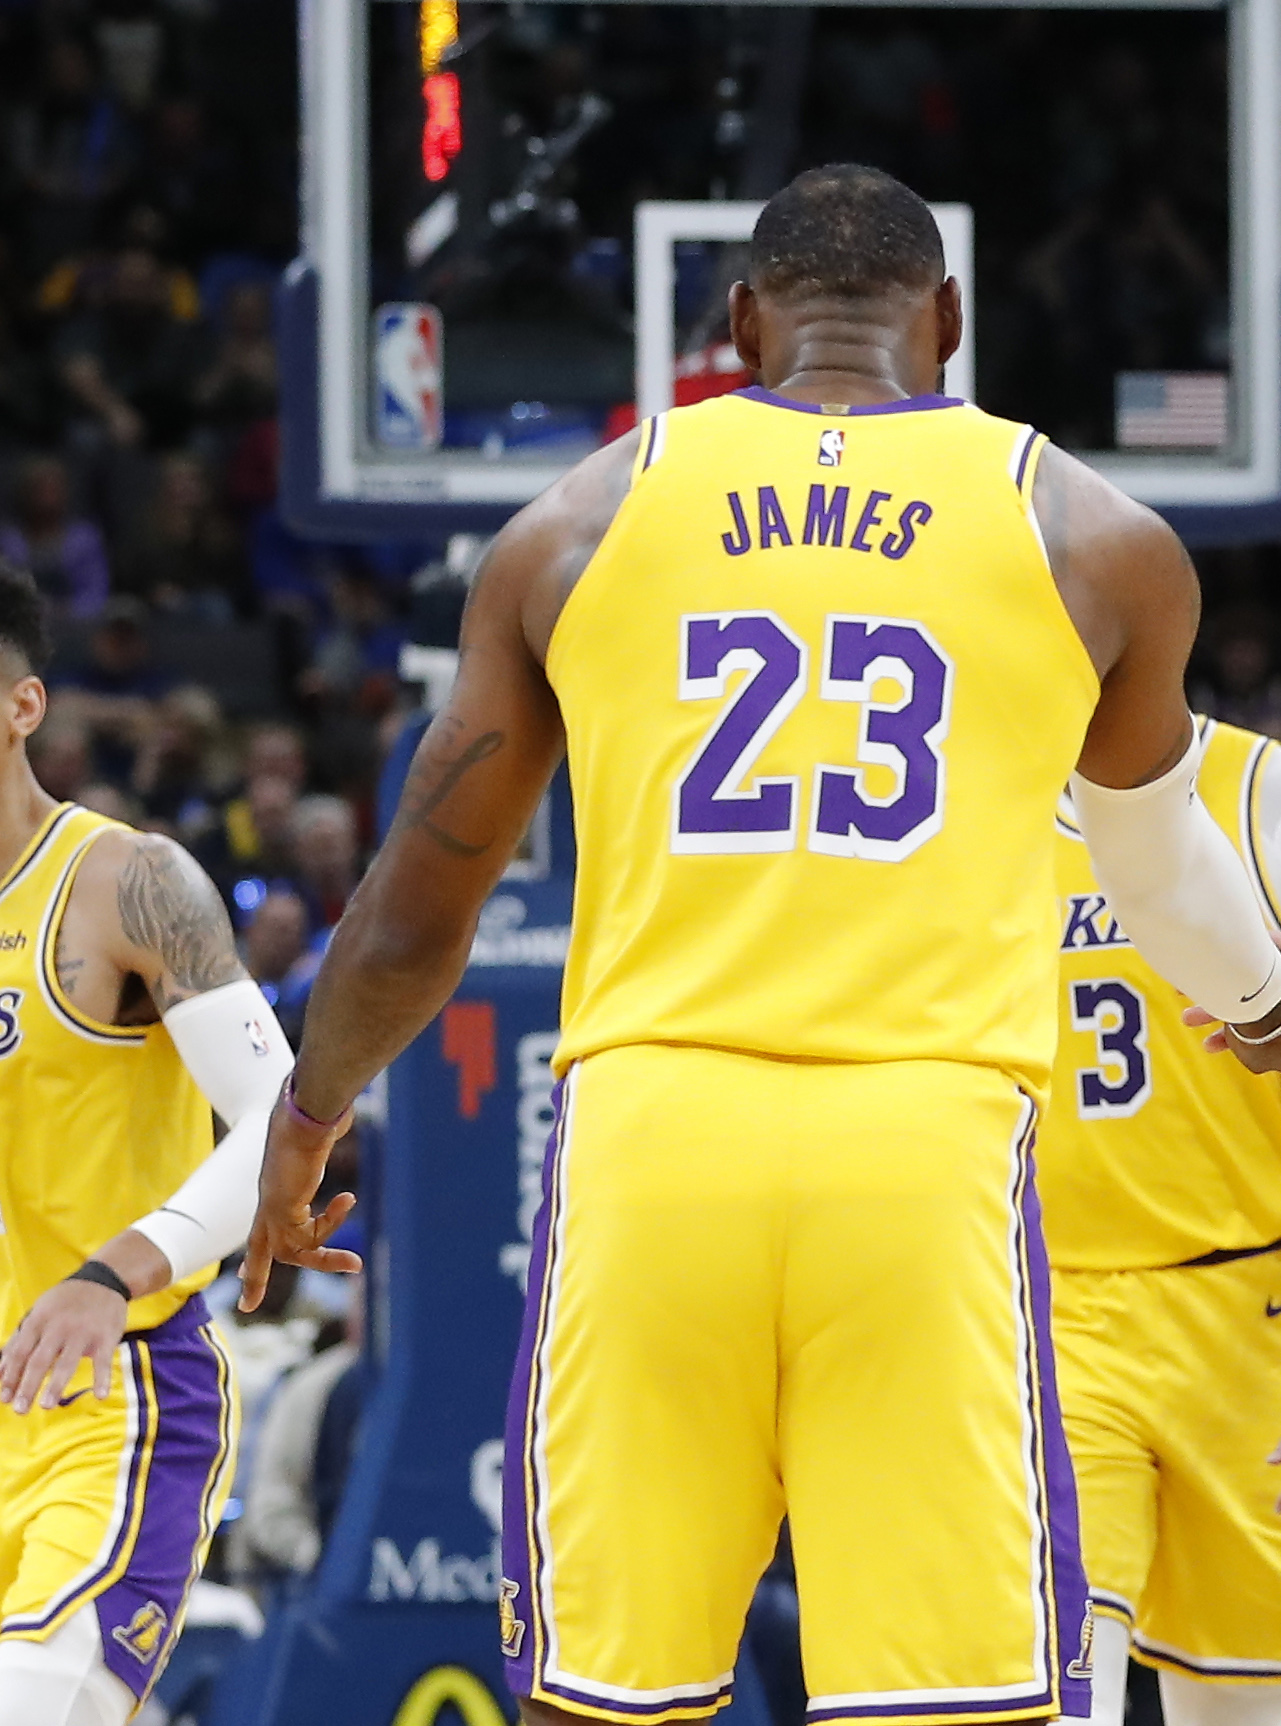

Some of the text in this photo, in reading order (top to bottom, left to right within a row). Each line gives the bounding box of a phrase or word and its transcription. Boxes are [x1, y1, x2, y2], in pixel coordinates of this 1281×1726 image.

[721, 484, 933, 561] JAMES
[670, 608, 956, 864] 23
[1069, 977, 1154, 1121] 3
